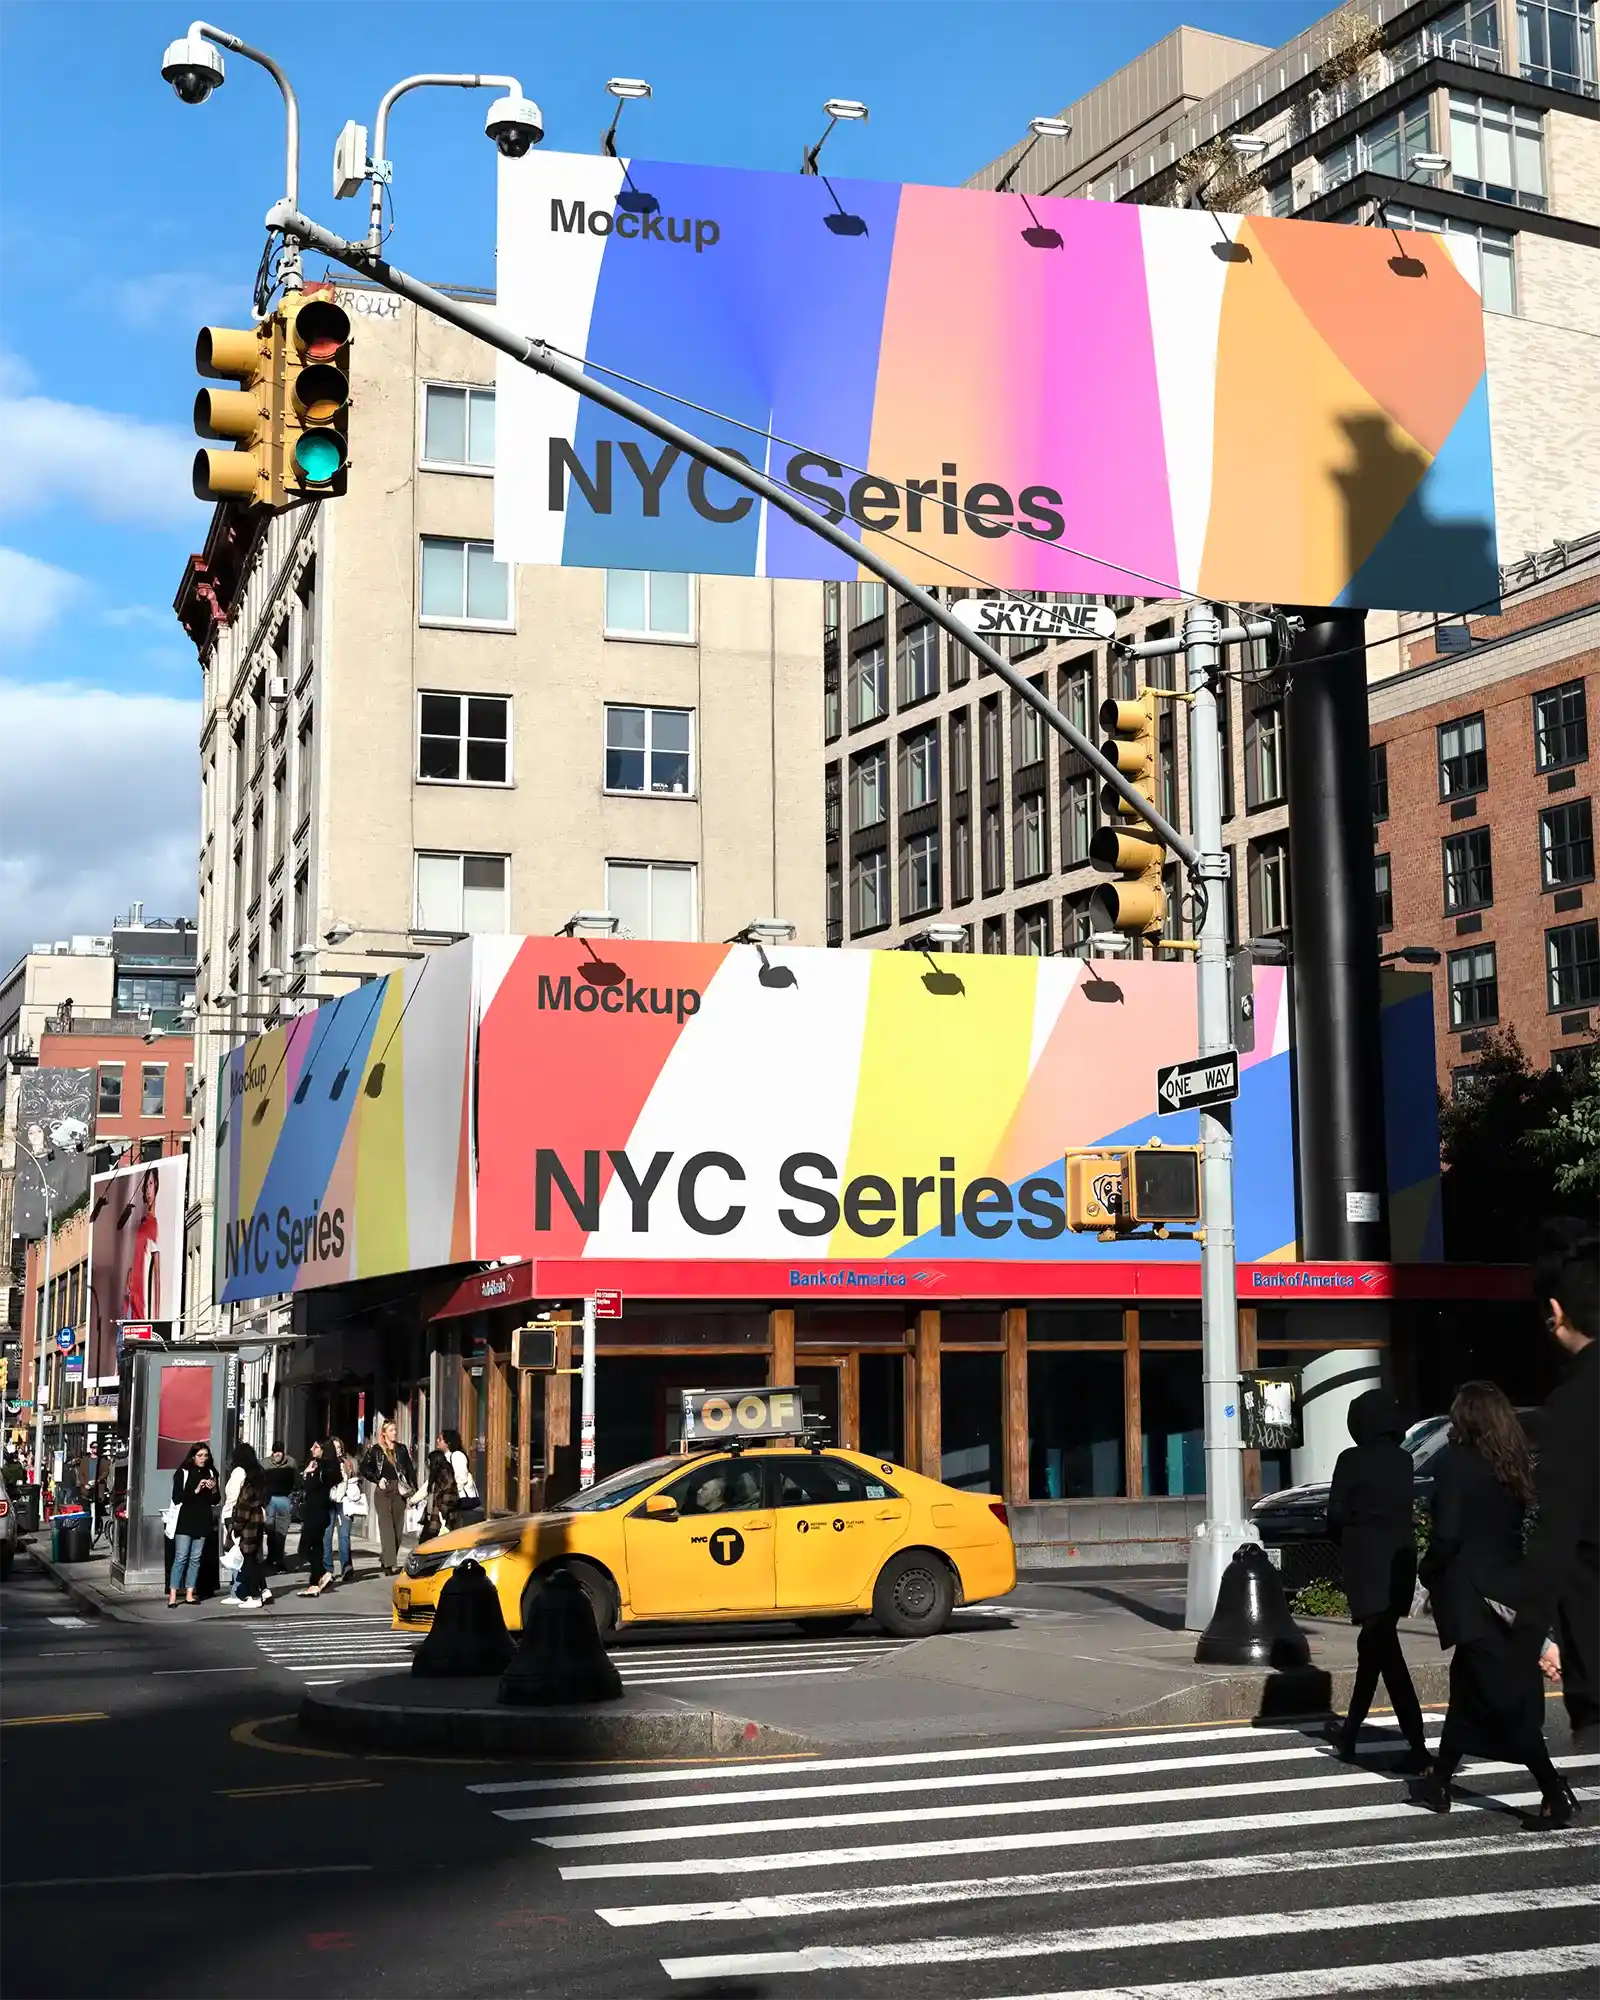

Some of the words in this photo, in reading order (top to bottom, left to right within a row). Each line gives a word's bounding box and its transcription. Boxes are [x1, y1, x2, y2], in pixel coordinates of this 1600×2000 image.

[551, 198, 720, 253] Mockup
[548, 437, 755, 524] NYC
[785, 451, 1066, 541] Series
[978, 602, 1098, 634] SKYLINE
[538, 975, 701, 1024] Mockup
[230, 1063, 267, 1097] Mockup
[1166, 1076, 1192, 1098] ONE
[1205, 1066, 1231, 1090] WAY
[536, 1149, 746, 1236] NYC
[779, 1152, 1066, 1239] Series
[225, 1212, 270, 1279] NYC
[275, 1199, 345, 1270] Series
[789, 1270, 827, 1286] Bank
[829, 1270, 845, 1286] of
[846, 1270, 907, 1286] America
[1252, 1271, 1286, 1287] Bank
[1287, 1271, 1301, 1287] of
[1301, 1271, 1354, 1287] America
[227, 1353, 238, 1408] Newsstand
[701, 1394, 794, 1431] OOF
